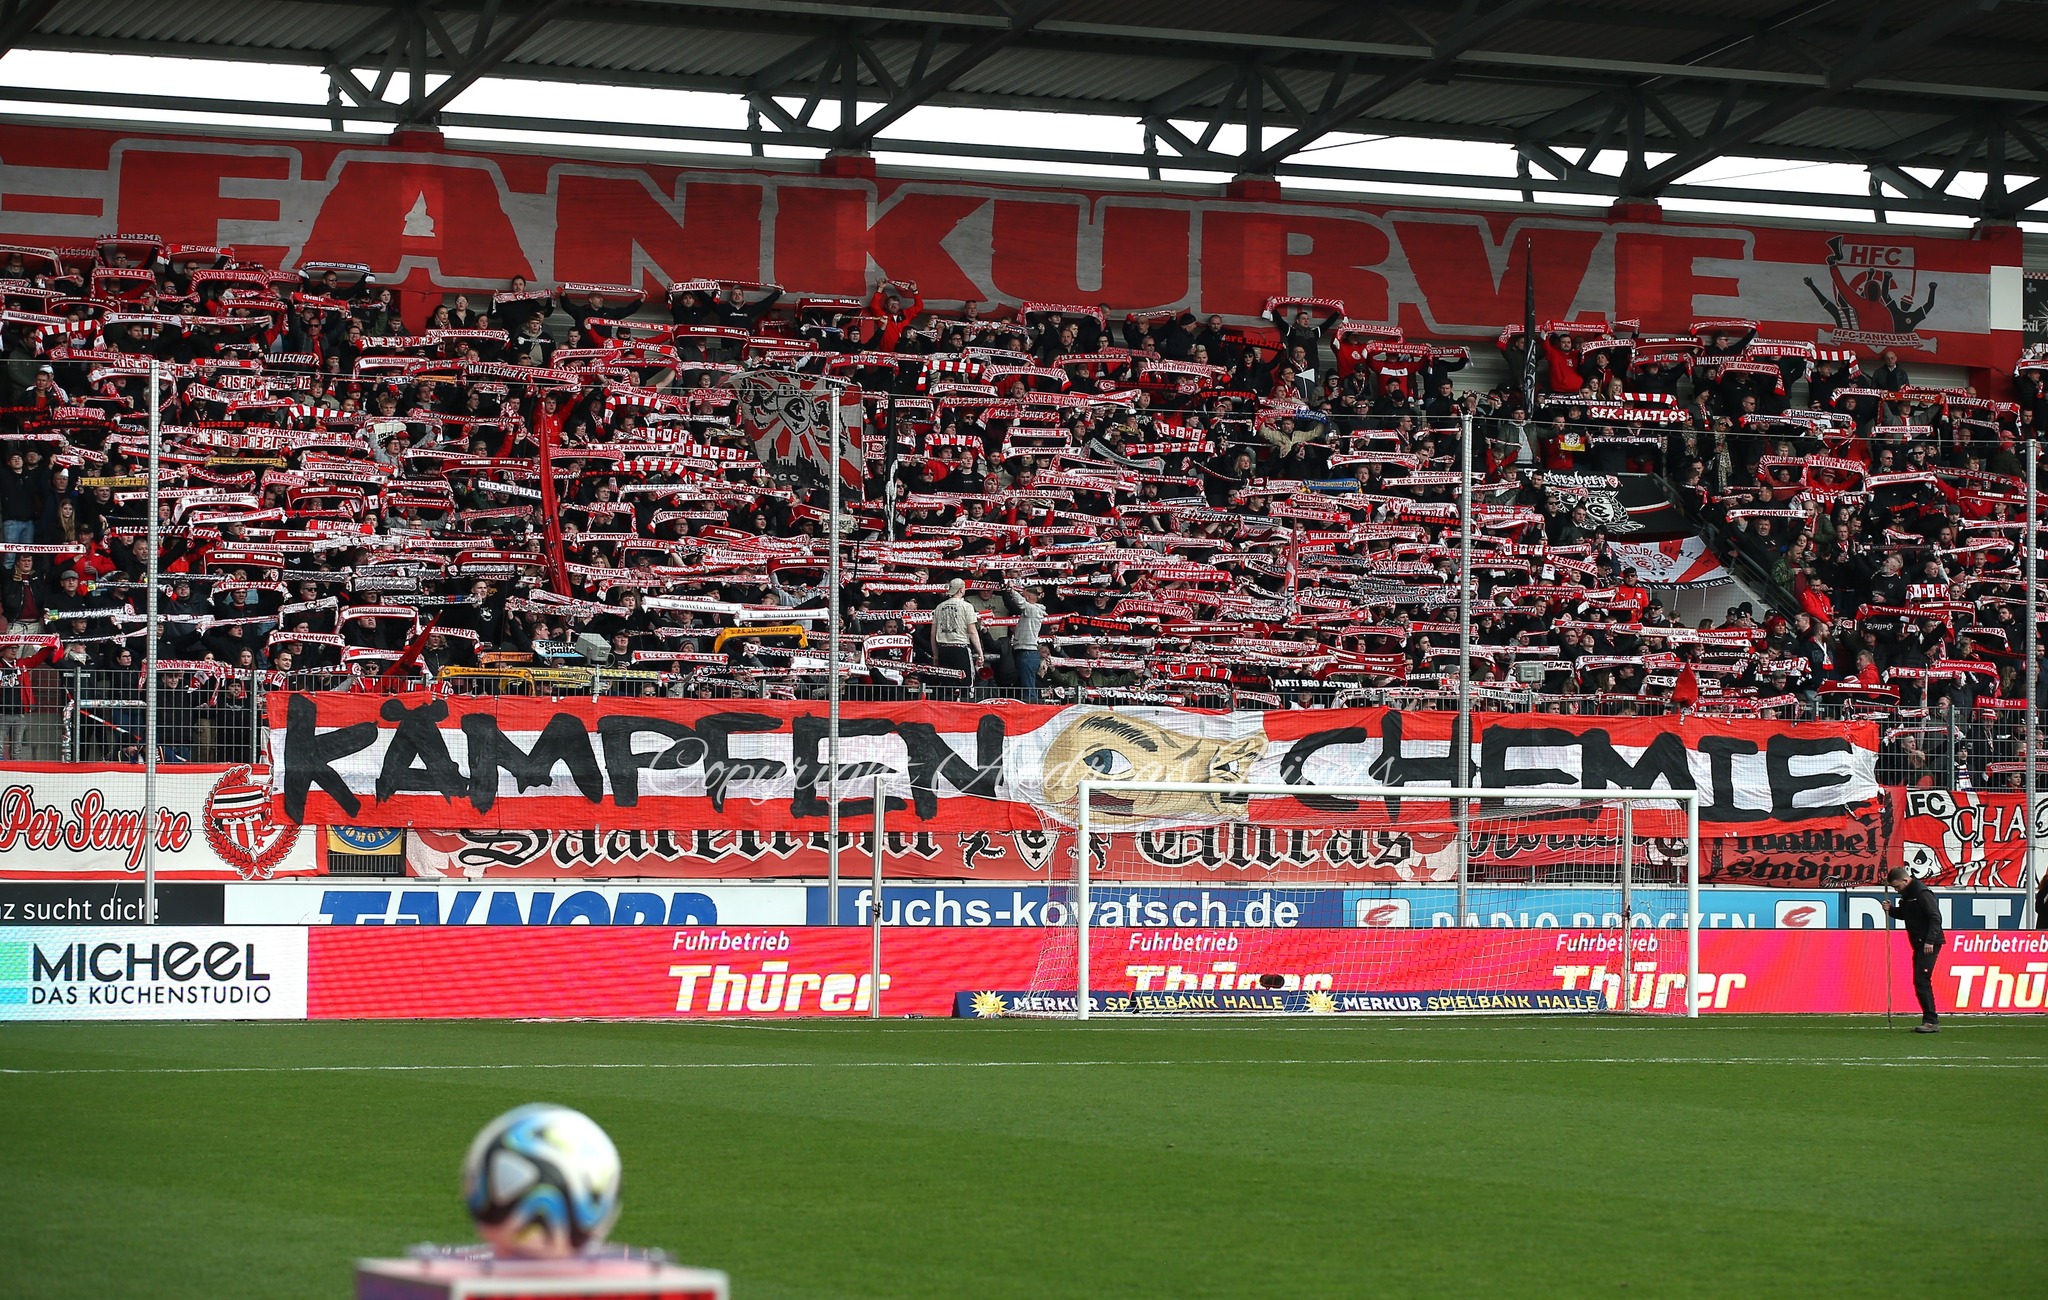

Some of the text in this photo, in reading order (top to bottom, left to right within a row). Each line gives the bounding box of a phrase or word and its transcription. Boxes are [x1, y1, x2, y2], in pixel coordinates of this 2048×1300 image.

[110, 137, 1756, 337] FANKURVE
[1850, 245, 1902, 266] HFC
[1834, 329, 1919, 343] HFC-FANKURVE
[784, 340, 810, 348] HALLE
[264, 353, 312, 363] HALLESCHER
[1783, 347, 1806, 357] HALLE
[1977, 490, 2006, 498] CHEMIE
[318, 520, 362, 532] HFC CHEMIE
[1420, 516, 1462, 525] CHEMI
[1029, 526, 1076, 534] HALLESCHER
[579, 533, 638, 541] HFC-FANKURVE
[412, 540, 490, 548] KURT-WABBEL-STADION
[253, 554, 282, 564] HALLE
[472, 552, 502, 560] CHEMIE
[1692, 578, 1734, 590] SIEGEN
[1090, 620, 1129, 631] CHEMIE
[273, 632, 339, 644] HFC-FANKURVE
[1275, 679, 1300, 688] ANTI
[1322, 680, 1358, 688] ACTION
[284, 693, 1005, 826] KÄMPFEN
[1280, 708, 1856, 823] CHEMIE
[0, 785, 191, 872] Per Sempre
[23, 896, 160, 920] sucht dich!
[855, 889, 1299, 927] fuchs-kovatsch.de
[672, 931, 790, 953] Fuhrbetrieb
[1129, 932, 1239, 952] Fuhrbetrieb
[1953, 934, 2048, 954] Fuhrbetrieb
[668, 961, 893, 1013] Thürer
[1552, 961, 1747, 1010] Thürer
[1949, 962, 2048, 1009] Thü
[32, 984, 271, 1005] DAS KÜCHENSTUDIO
[1013, 994, 1599, 1012] MERKR SPIELBANK HALLE MERKUR SPIELBANK HALLE
